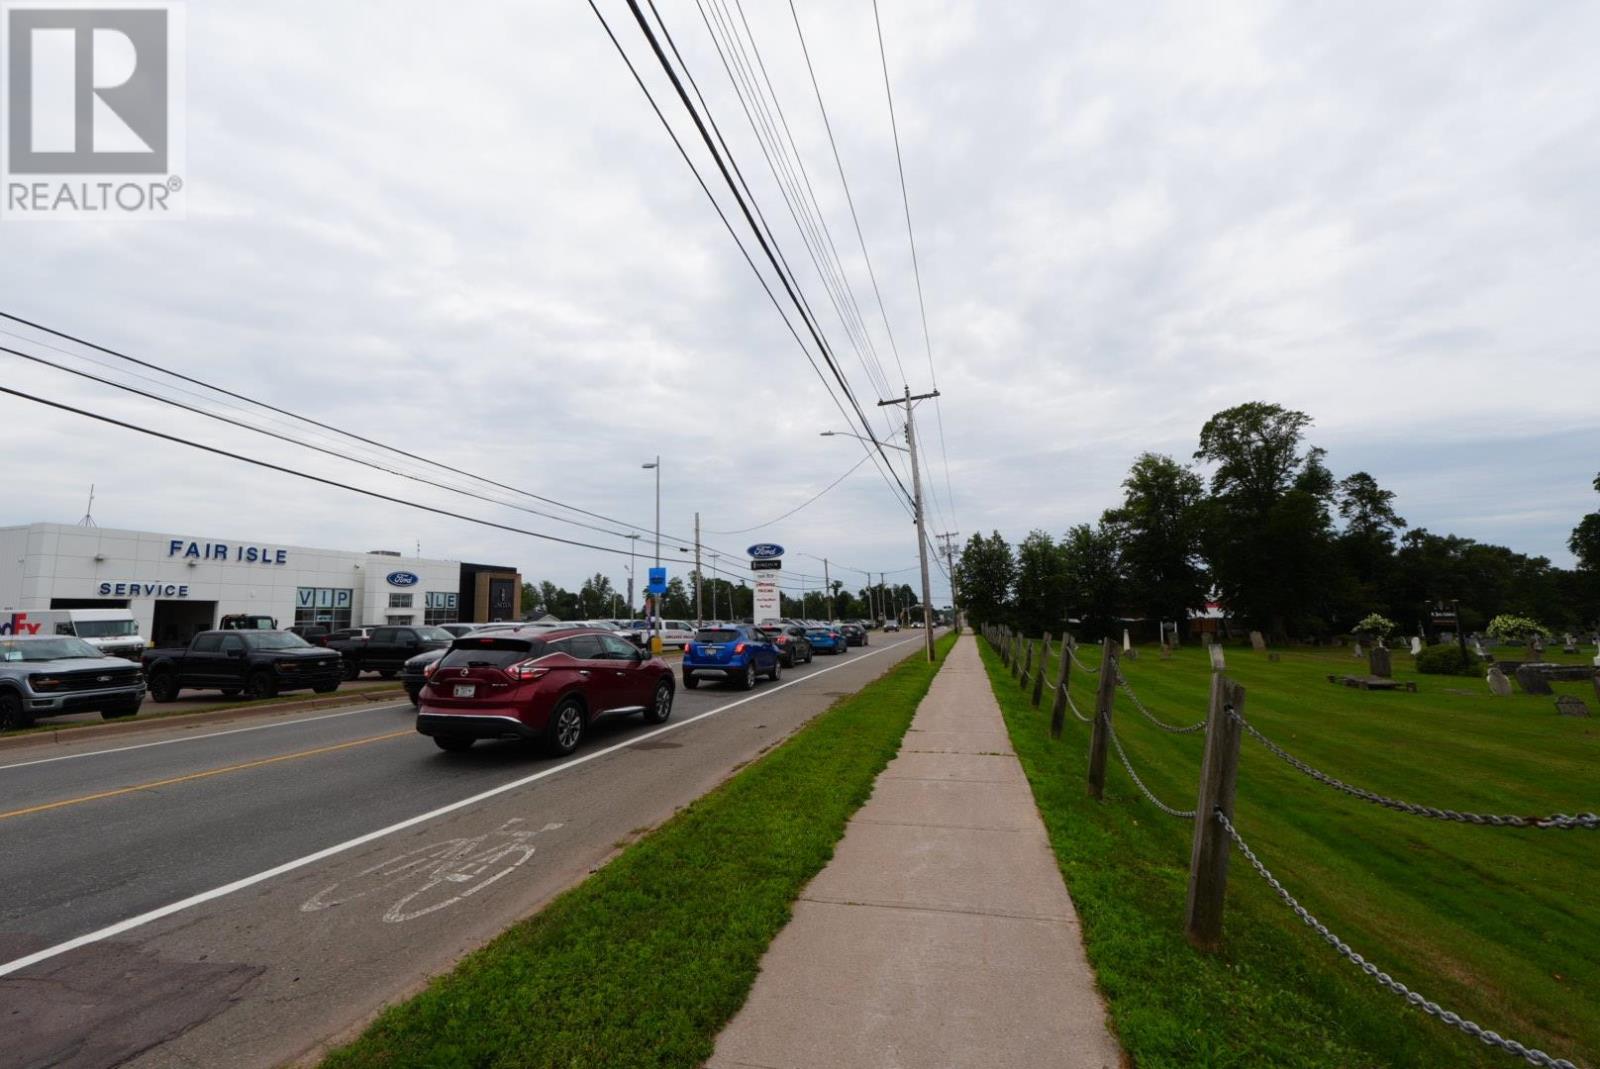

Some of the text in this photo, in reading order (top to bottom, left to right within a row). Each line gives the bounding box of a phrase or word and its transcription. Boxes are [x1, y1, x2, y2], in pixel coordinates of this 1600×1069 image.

[168, 539, 287, 564] FAIR ISLE
[99, 582, 189, 599] SERVICE
[299, 590, 348, 606] VIP
